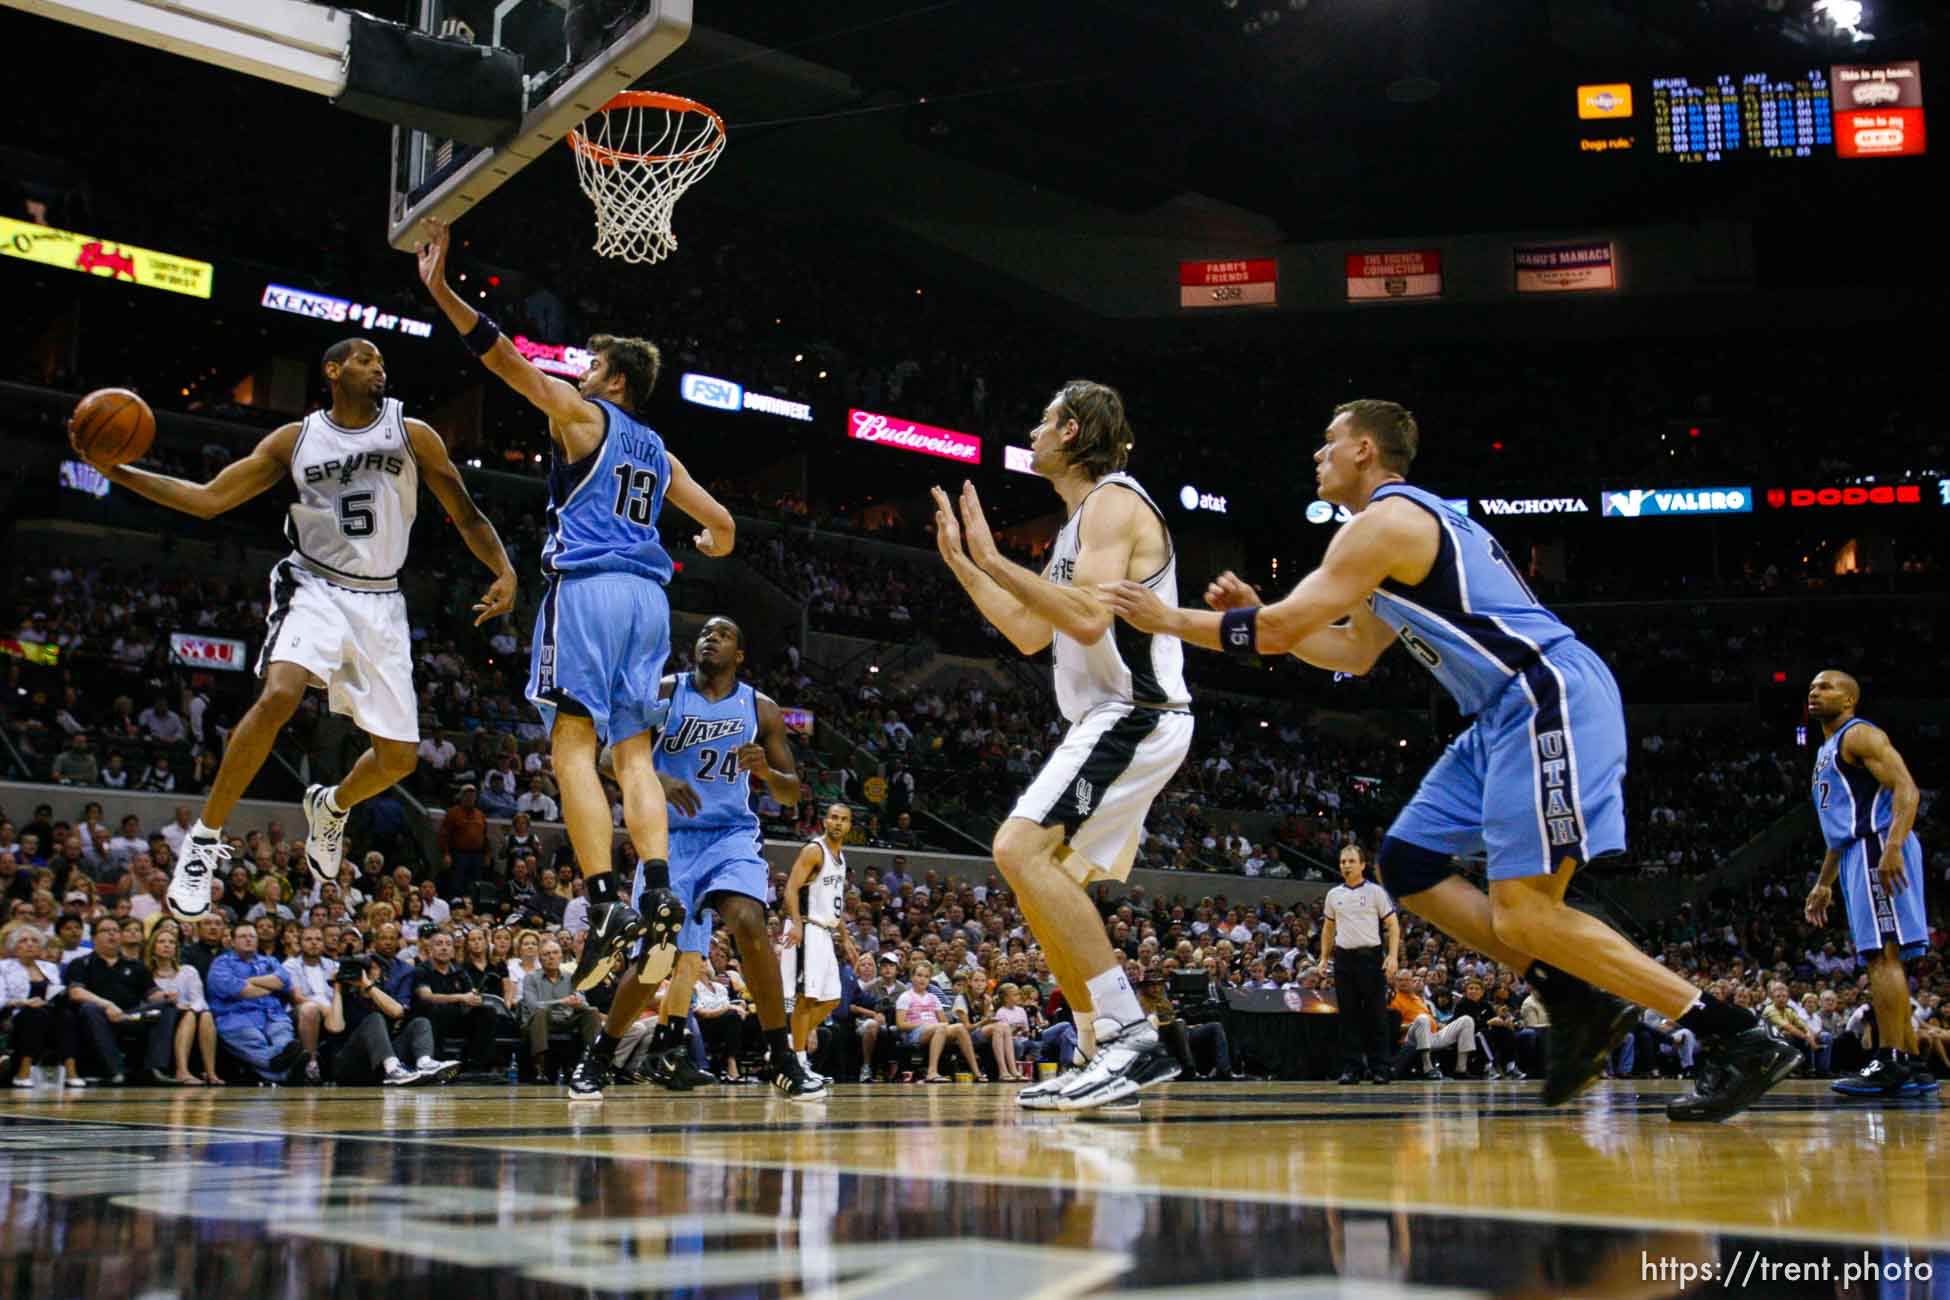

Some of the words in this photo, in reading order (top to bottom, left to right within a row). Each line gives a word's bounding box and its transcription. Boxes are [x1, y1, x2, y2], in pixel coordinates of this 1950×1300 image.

[1653, 78, 1687, 89] SPURS
[1559, 247, 1610, 264] MANIACS
[1205, 272, 1249, 284] FRIENDS
[375, 313, 398, 330] AT
[399, 317, 432, 337] TEN
[692, 379, 733, 405] FSN
[852, 411, 976, 458] Budweiser
[303, 452, 404, 486] SPURS
[614, 462, 659, 528] 13
[1479, 498, 1589, 515] WACHOVIA
[1655, 490, 1745, 511] VALERO
[1791, 485, 1921, 507] DODGE
[338, 490, 378, 539] 5
[1231, 623, 1249, 647] 15
[696, 747, 739, 784] 24
[1538, 730, 1578, 846] UTAH
[1818, 781, 1831, 810] 2
[833, 895, 843, 919] 9
